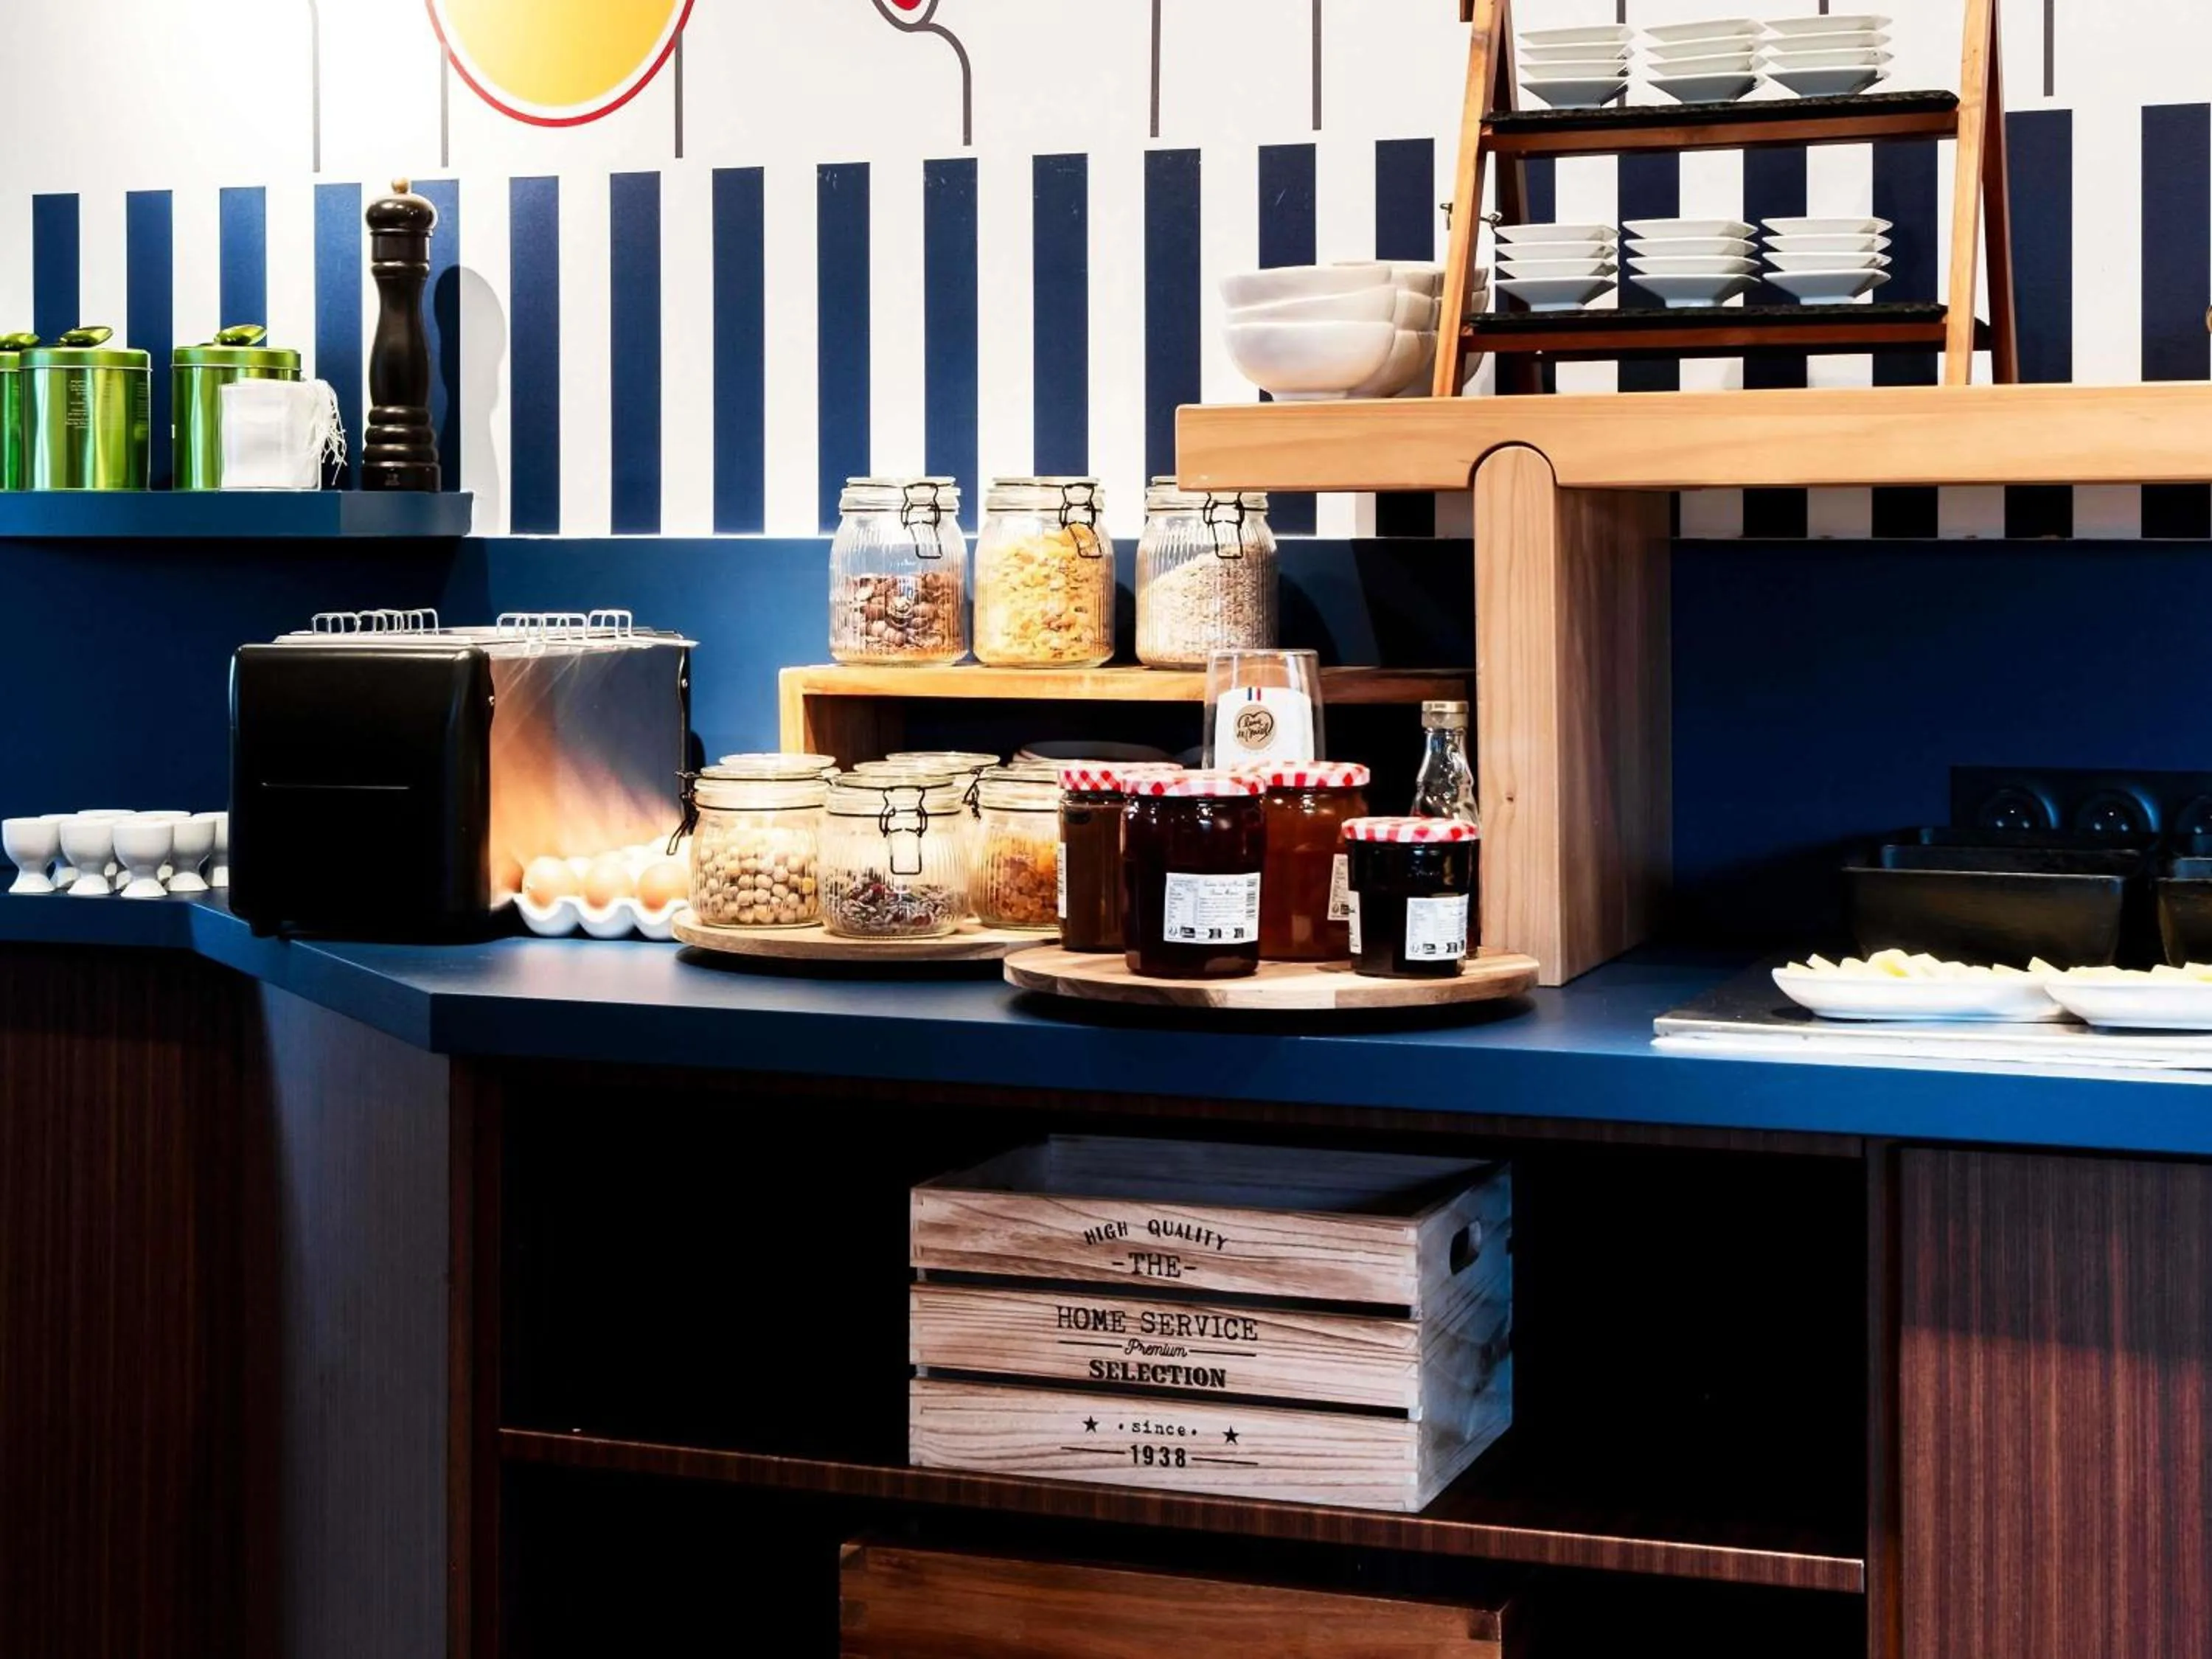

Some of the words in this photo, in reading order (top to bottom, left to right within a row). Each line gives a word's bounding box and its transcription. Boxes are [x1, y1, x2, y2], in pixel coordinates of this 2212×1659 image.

[1083, 1220, 1128, 1245] HIGH
[1148, 1219, 1228, 1251] QUALITY
[1057, 1306, 1127, 1333] HOME
[1140, 1311, 1258, 1340] SERVICE
[1124, 1338, 1188, 1357] Premium
[1089, 1360, 1226, 1388] SELECTION
[1130, 1444, 1186, 1467] 1938
